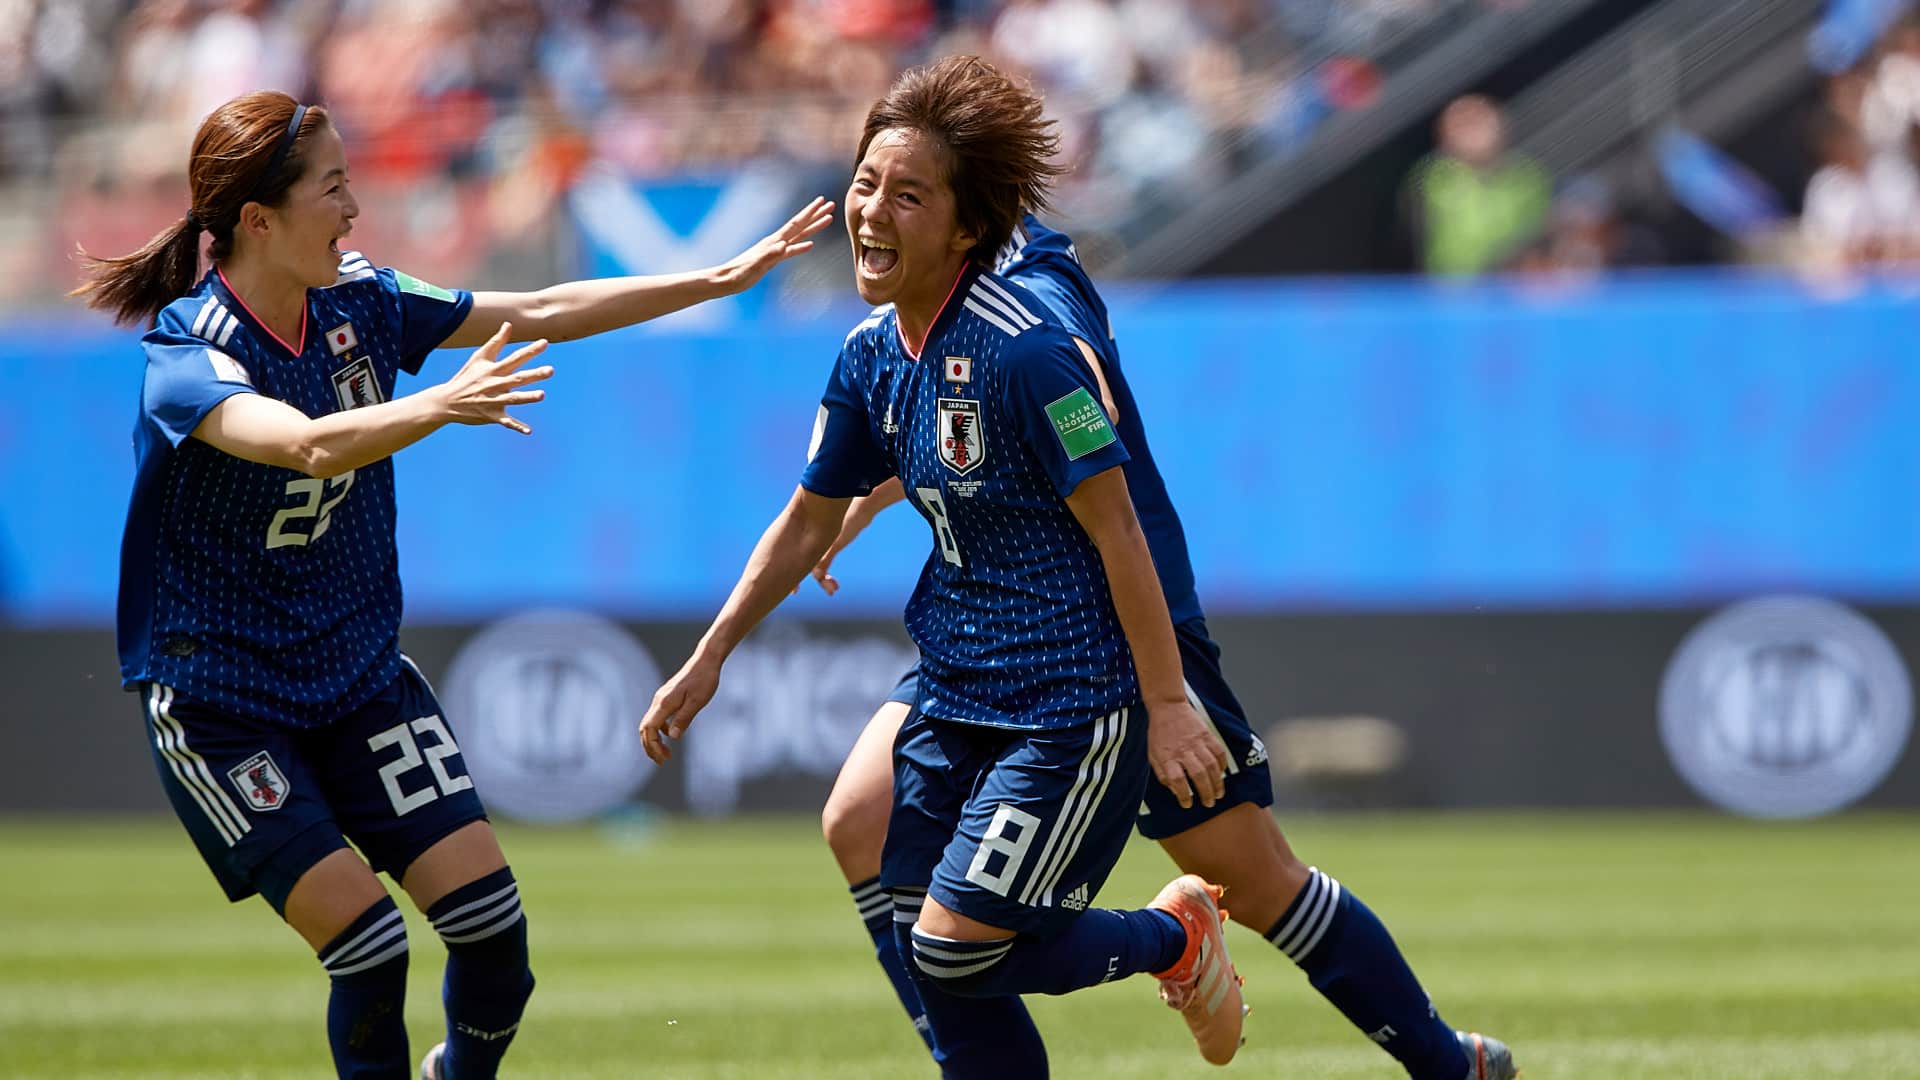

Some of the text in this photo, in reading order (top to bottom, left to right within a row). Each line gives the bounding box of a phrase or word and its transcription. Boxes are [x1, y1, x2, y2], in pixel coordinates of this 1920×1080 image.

[947, 402, 969, 410] JAPAN
[1087, 419, 1105, 433] FIFA
[265, 469, 355, 549] 22
[916, 487, 963, 568] 8
[367, 714, 475, 817] 22
[965, 802, 1042, 898] 8
